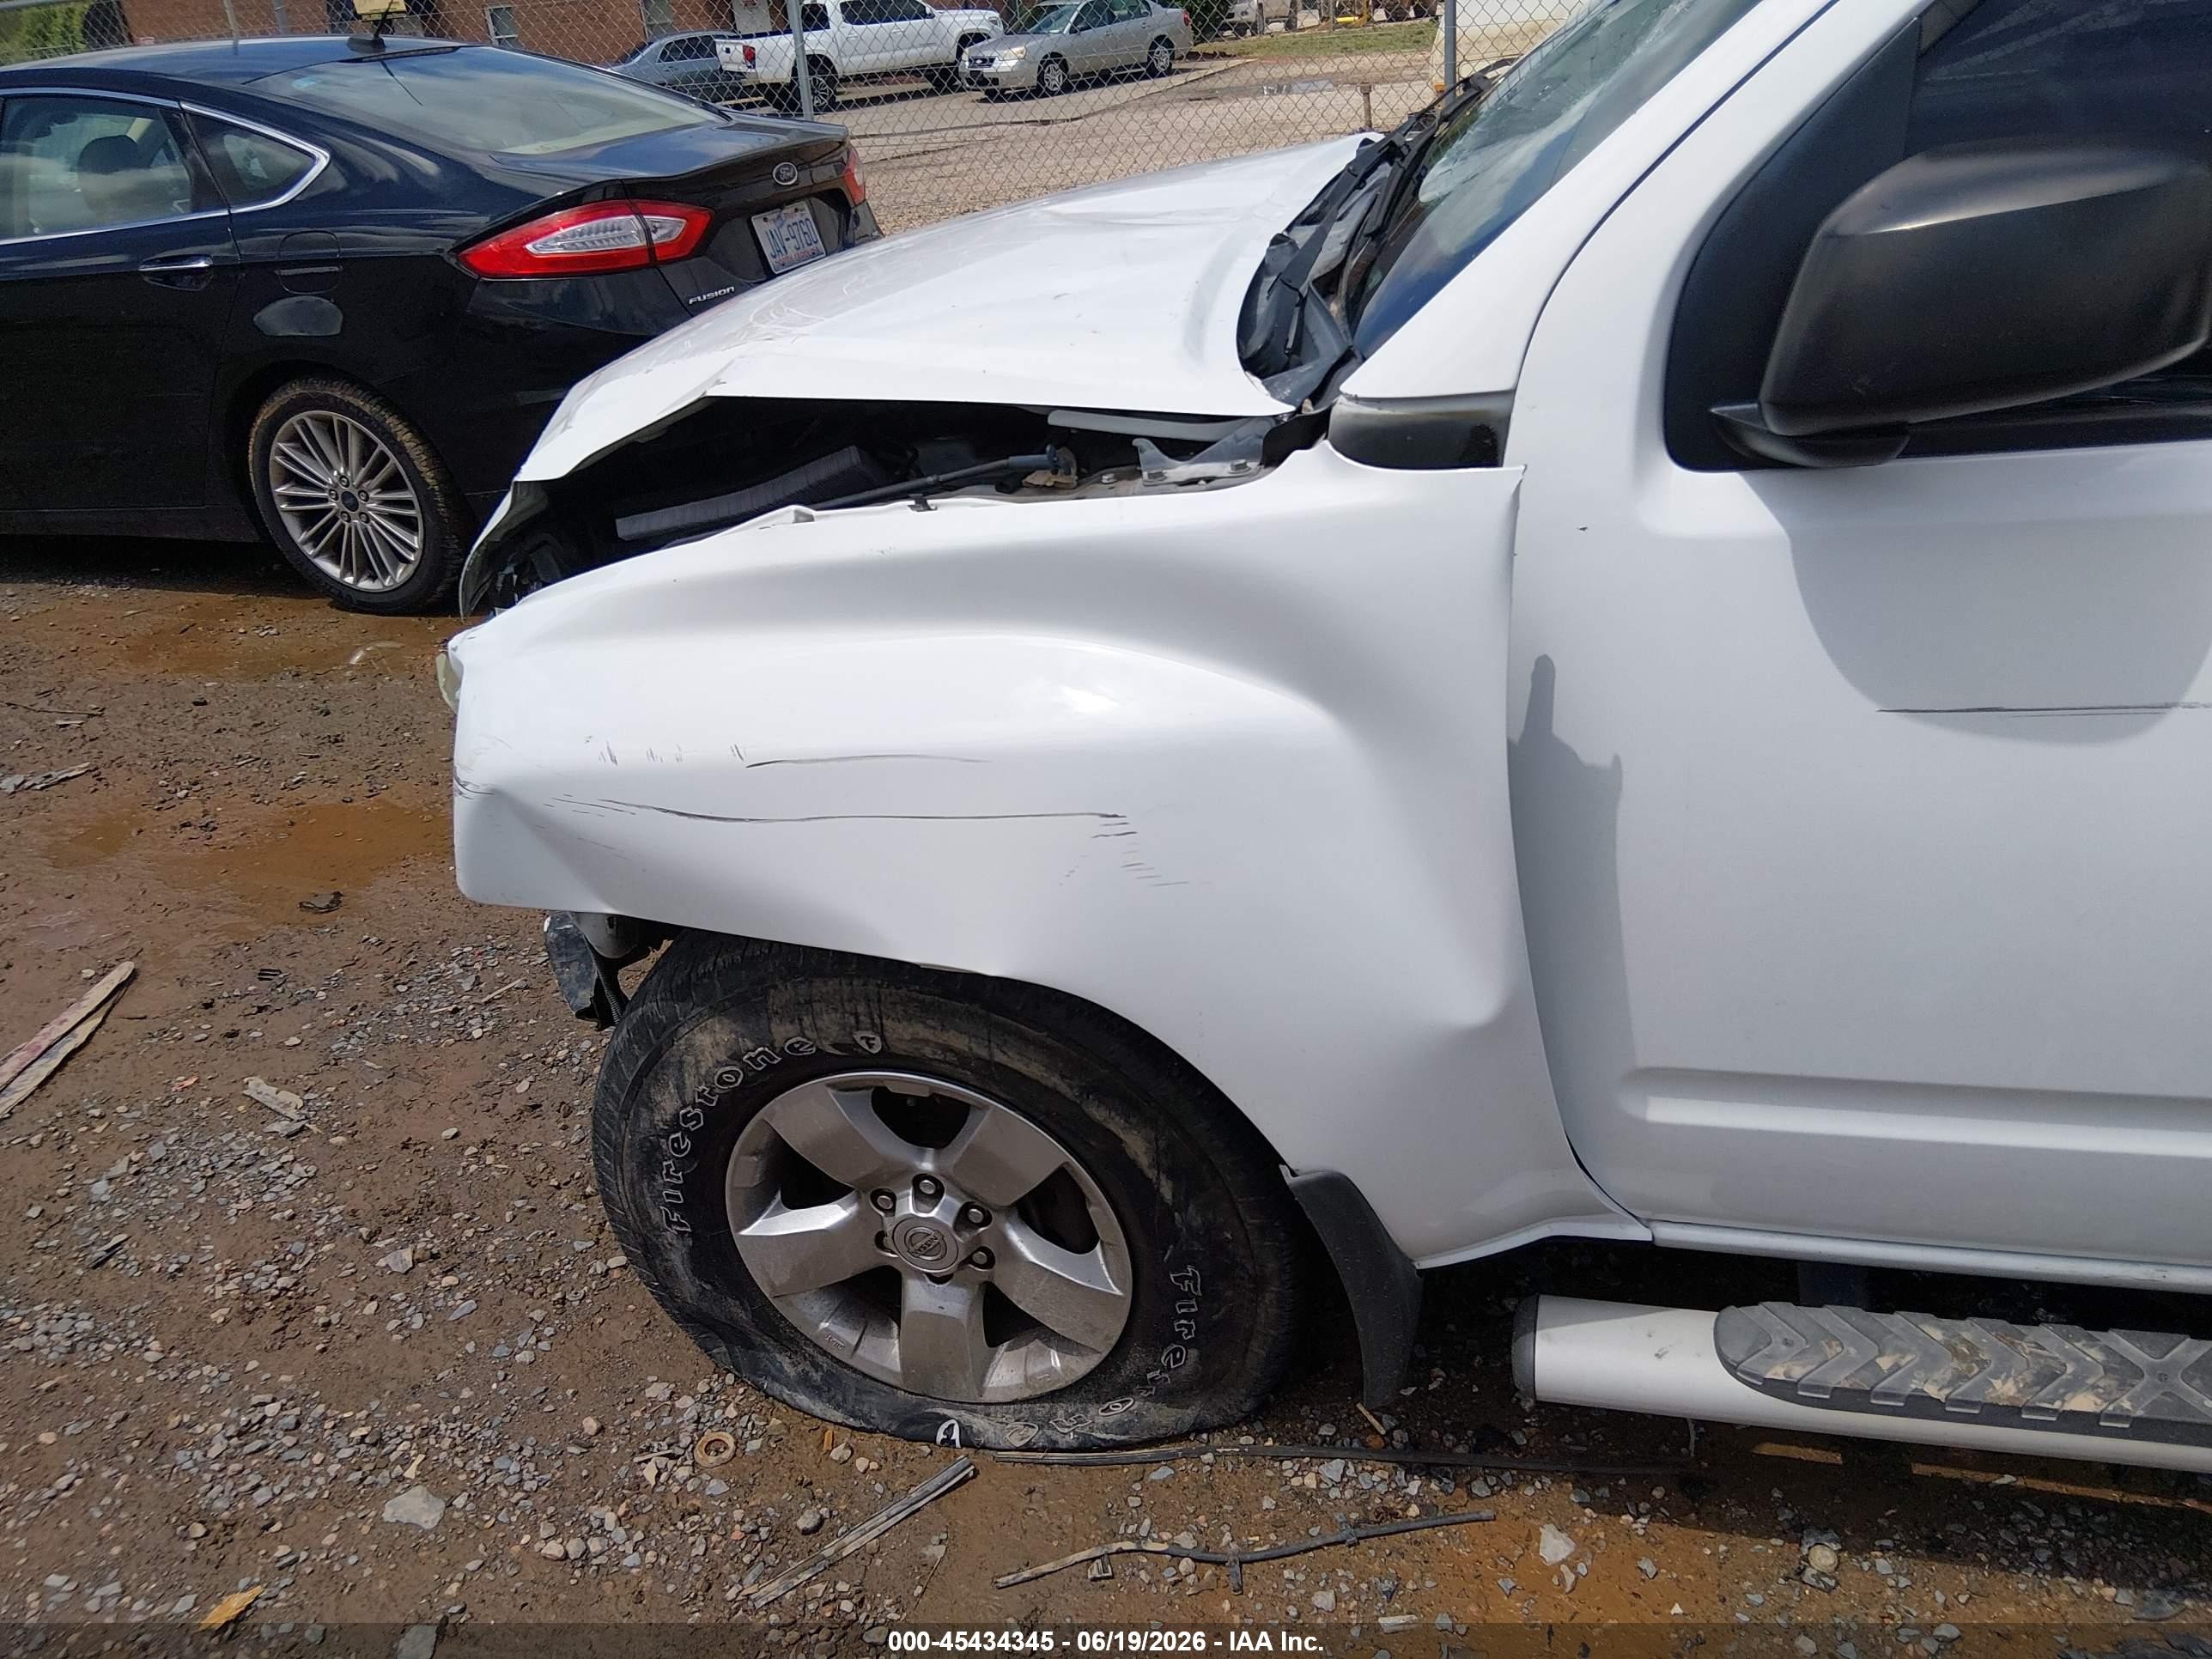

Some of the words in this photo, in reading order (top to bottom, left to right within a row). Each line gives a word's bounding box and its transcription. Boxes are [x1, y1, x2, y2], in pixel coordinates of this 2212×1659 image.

[766, 218, 818, 258] JAV-9760
[689, 286, 735, 305] FUSION
[659, 1036, 817, 1235] Firestone
